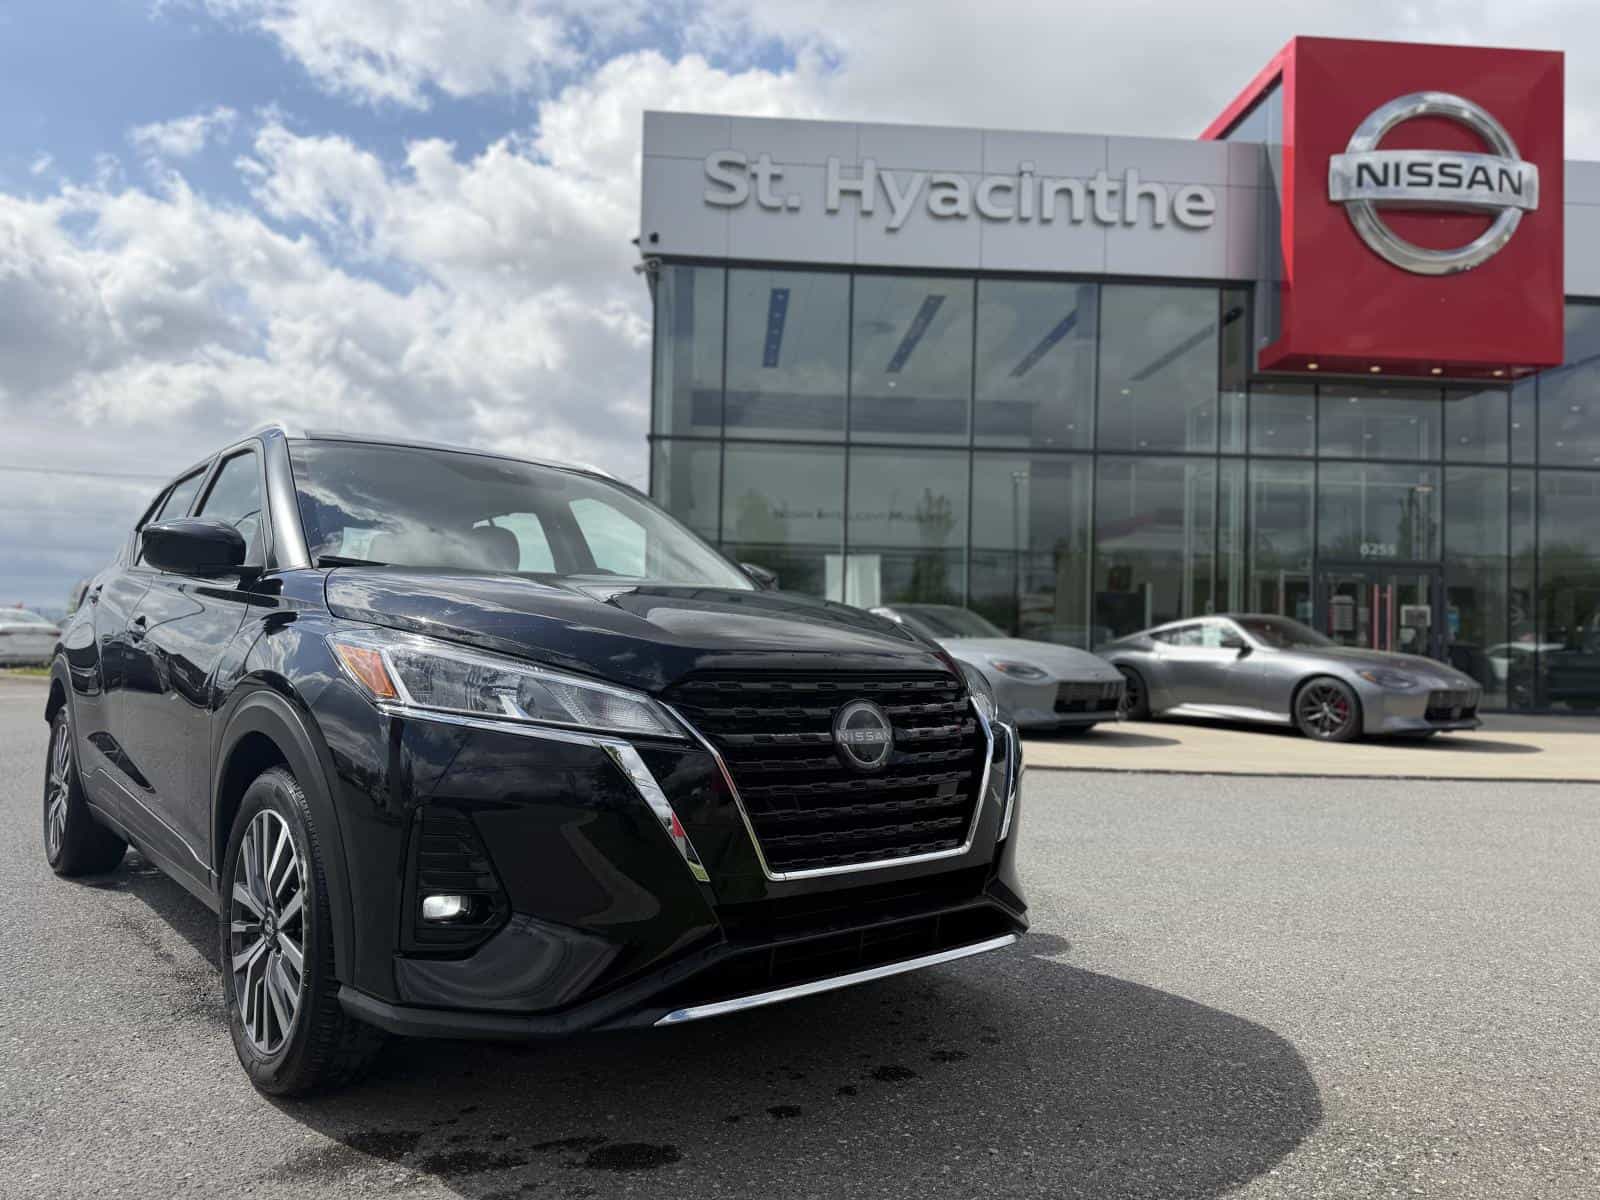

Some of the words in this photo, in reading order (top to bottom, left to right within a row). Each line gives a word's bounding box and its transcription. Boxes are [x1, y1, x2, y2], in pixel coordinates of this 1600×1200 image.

[704, 151, 800, 211] St.
[825, 156, 1217, 233] Hyacinthe
[1356, 162, 1523, 196] NISSAN
[837, 730, 891, 743] NISSAN
